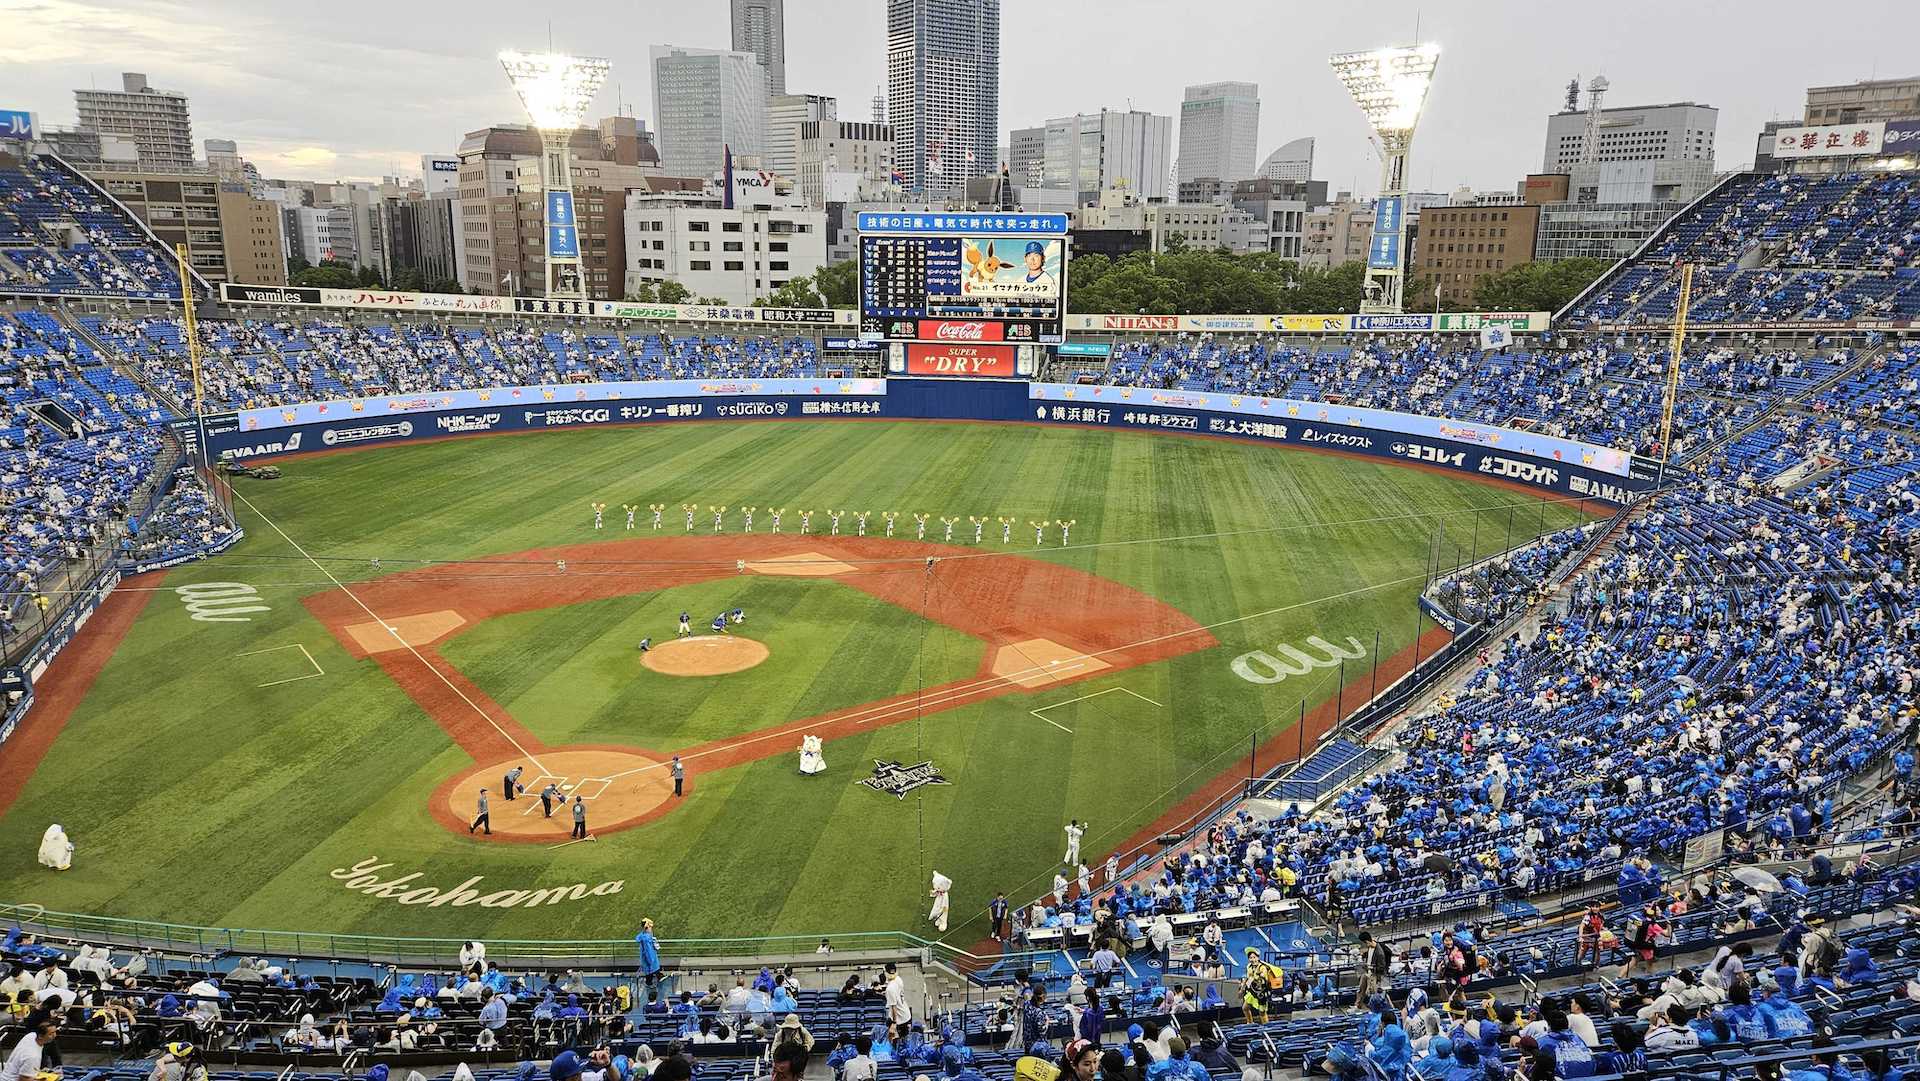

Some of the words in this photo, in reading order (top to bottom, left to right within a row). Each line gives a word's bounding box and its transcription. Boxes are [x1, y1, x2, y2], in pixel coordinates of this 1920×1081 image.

[740, 181, 769, 190] YMCA
[245, 290, 302, 303] wamiles
[707, 307, 755, 320] 扶桑電機
[764, 310, 806, 321] 昭和大学
[1105, 316, 1162, 328] NITTAN
[937, 322, 984, 339] Coca-Cola
[949, 348, 977, 356] SUPER
[729, 404, 775, 416] SUGIKO
[819, 401, 881, 414] 横浜信用金庫
[1052, 406, 1111, 424] 横浜銀行
[1239, 422, 1288, 439] 大洋建設
[1314, 430, 1372, 449] レイズネクスト
[1407, 444, 1466, 467] ヨコレイ
[1493, 457, 1559, 485] コロワイド
[330, 855, 625, 909] Yokohama
